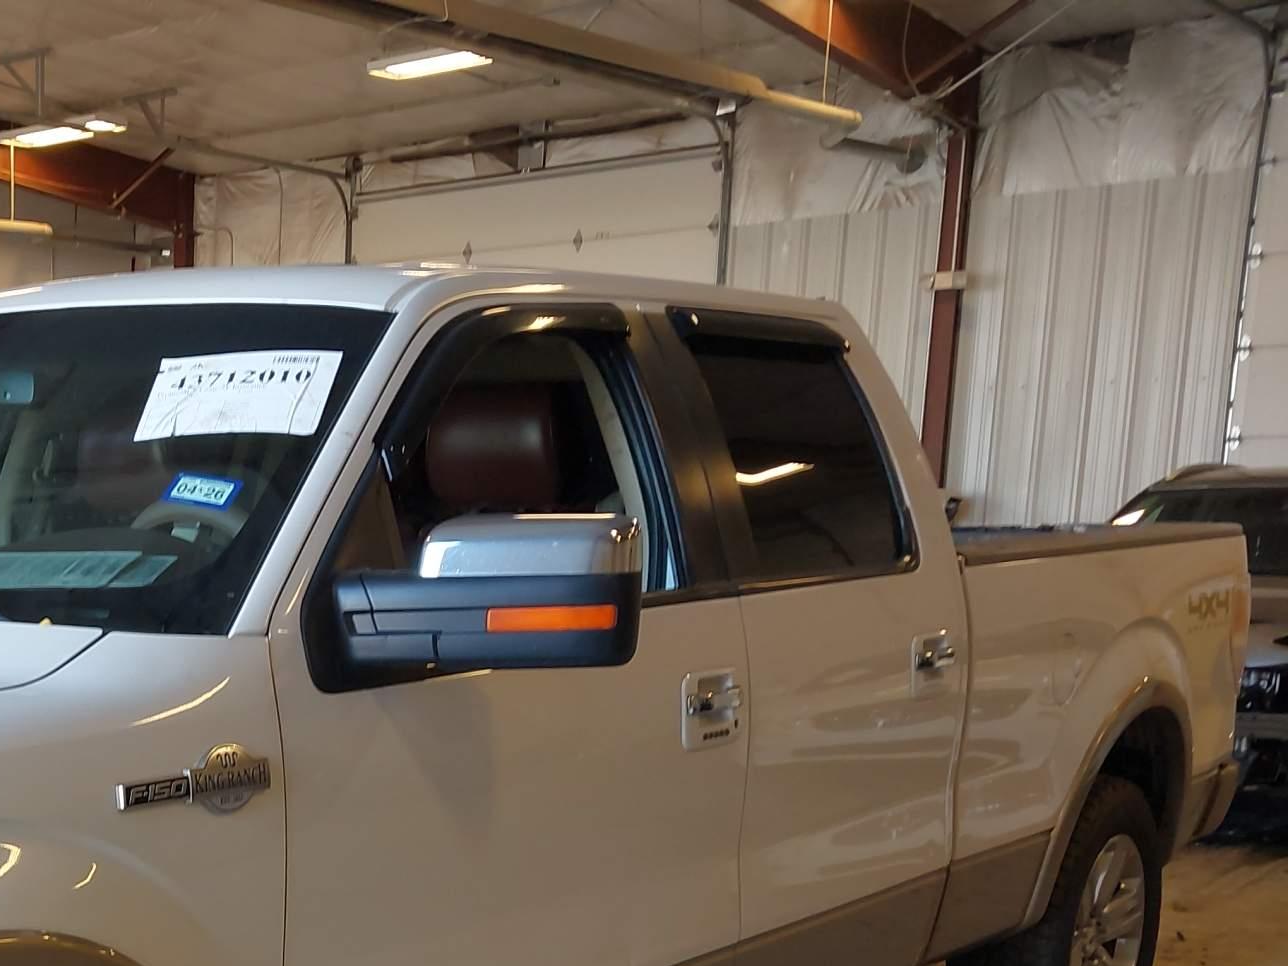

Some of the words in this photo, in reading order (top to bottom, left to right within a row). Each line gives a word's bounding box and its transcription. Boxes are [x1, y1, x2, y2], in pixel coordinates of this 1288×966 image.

[170, 368, 312, 390] 43712010
[194, 770, 226, 793] KING
[227, 763, 268, 788] RANCH
